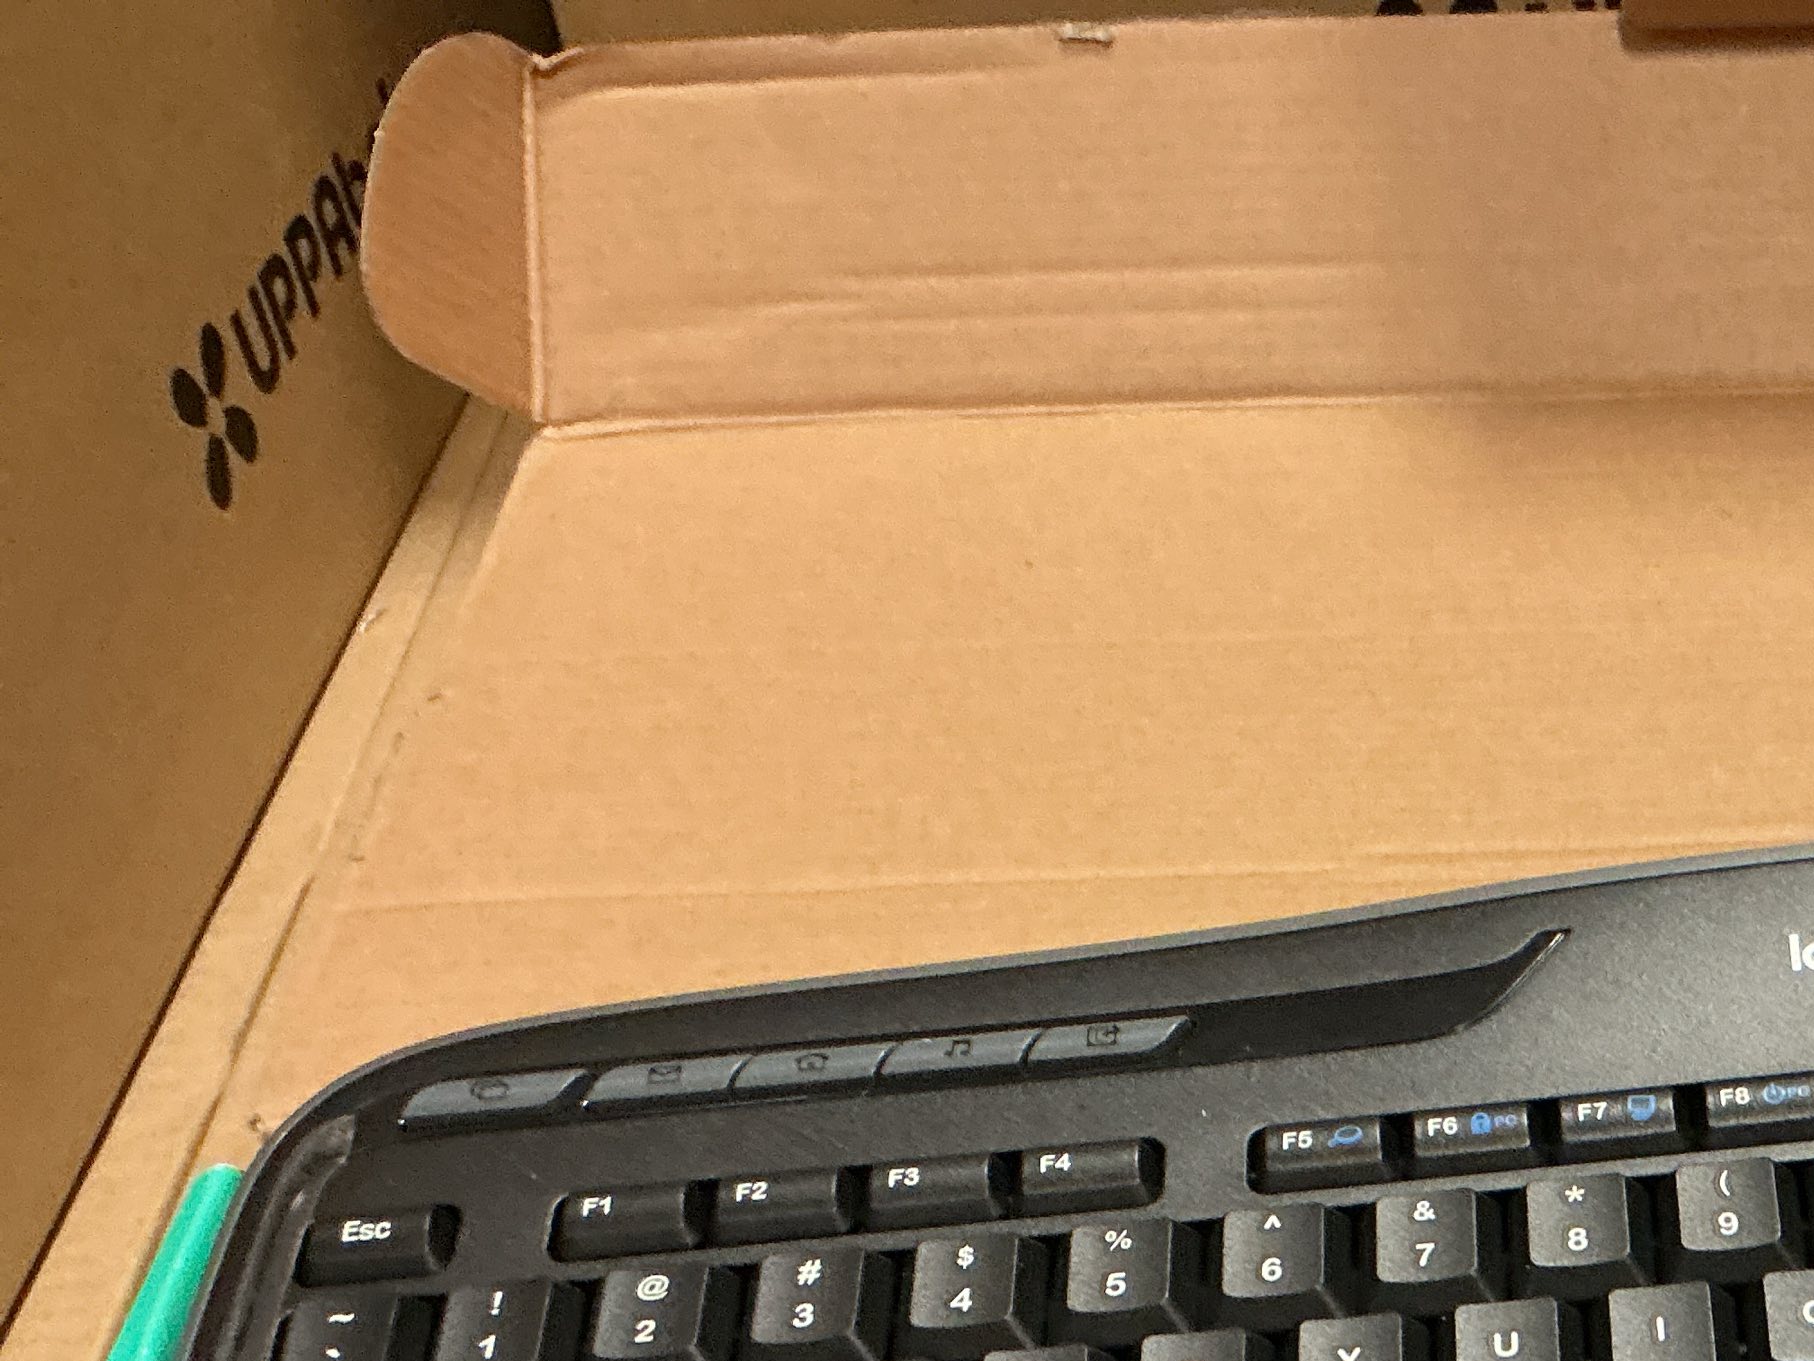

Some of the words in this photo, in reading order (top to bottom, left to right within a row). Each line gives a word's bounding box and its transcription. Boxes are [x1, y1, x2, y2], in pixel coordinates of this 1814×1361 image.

[1719, 1086, 1751, 1107] F8
[1577, 1101, 1608, 1122] F7
[1427, 1116, 1459, 1137] F6
[1282, 1130, 1313, 1151] F5
[1039, 1152, 1072, 1174] F4
[887, 1167, 920, 1188] F3
[1719, 1169, 1731, 1197] (
[735, 1181, 768, 1202] F2
[582, 1195, 612, 1217] F1
[1412, 1200, 1436, 1221] &
[341, 1219, 392, 1243] Esc
[1263, 1214, 1282, 1230] ^
[1717, 1211, 1739, 1236] 9
[1104, 1229, 1133, 1252] %
[1567, 1227, 1589, 1251] 8
[956, 1244, 975, 1270] $
[1415, 1242, 1435, 1267] 7
[797, 1258, 822, 1286] #
[1261, 1257, 1283, 1282] 6
[635, 1274, 670, 1301] @
[1105, 1271, 1127, 1297] 5
[490, 1290, 503, 1316] !
[949, 1287, 973, 1313] 4
[792, 1302, 814, 1328] 3
[634, 1319, 656, 1343] 2
[1655, 1316, 1666, 1342] I
[478, 1334, 496, 1360] 1
[1493, 1331, 1519, 1358] U
